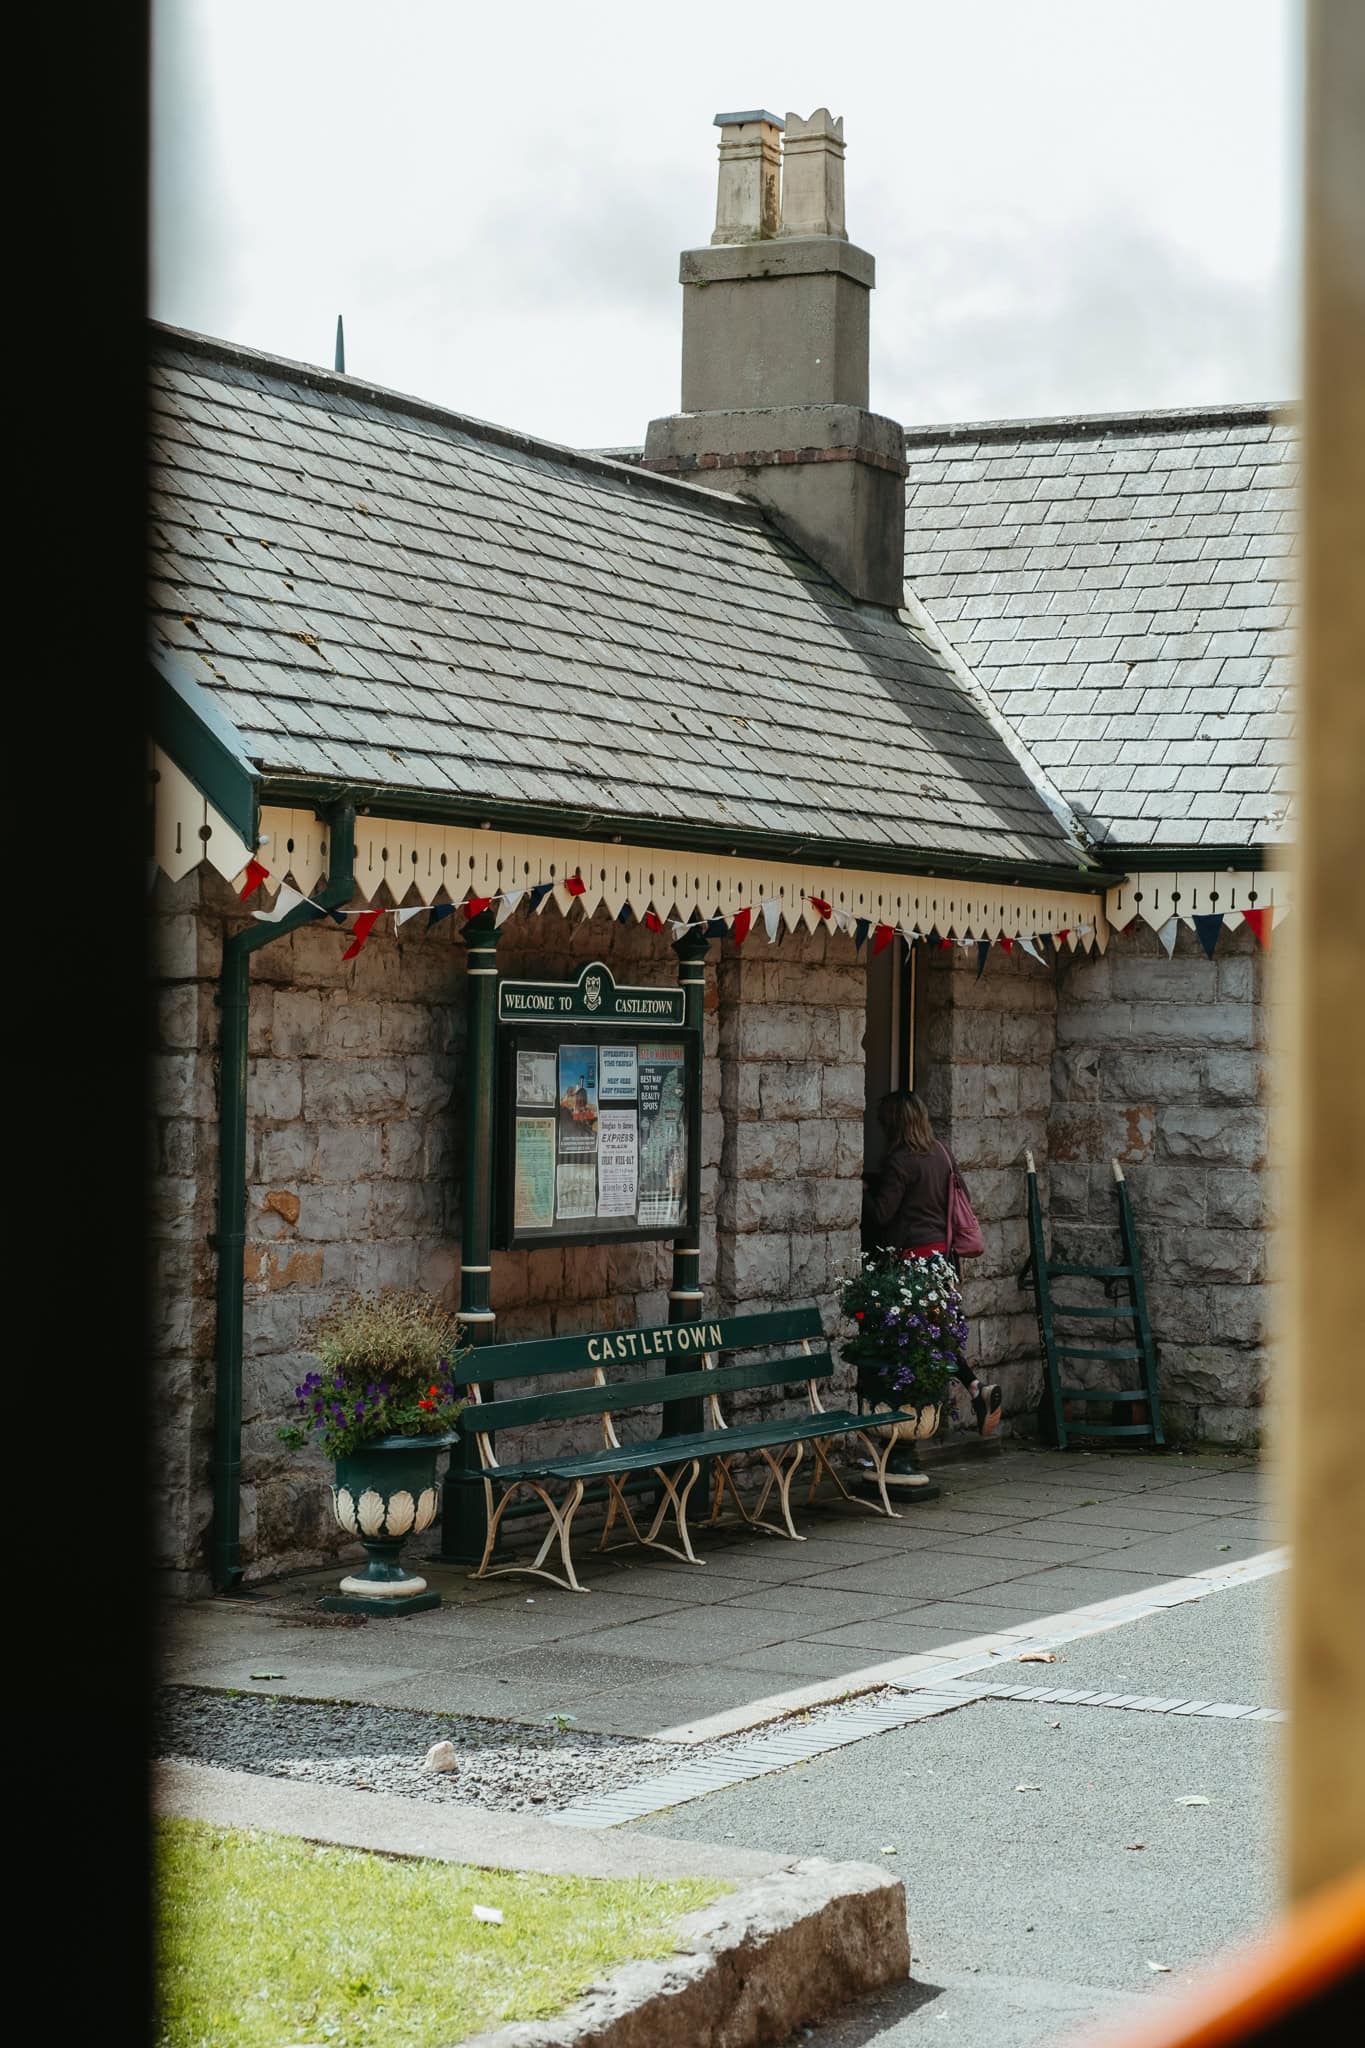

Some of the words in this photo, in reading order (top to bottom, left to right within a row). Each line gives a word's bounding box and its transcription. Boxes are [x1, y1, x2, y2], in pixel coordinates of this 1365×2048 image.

[504, 994, 555, 1010] WELCOME
[559, 996, 573, 1011] TO
[615, 999, 673, 1014] CASTLETOWN
[640, 1075, 652, 1084] BEST
[652, 1075, 662, 1084] WAY
[641, 1092, 660, 1101] BEAUTY
[643, 1102, 658, 1111] SPOTS
[601, 1133, 634, 1142] EXPRESS
[587, 1324, 723, 1361] CASTLETOWN
